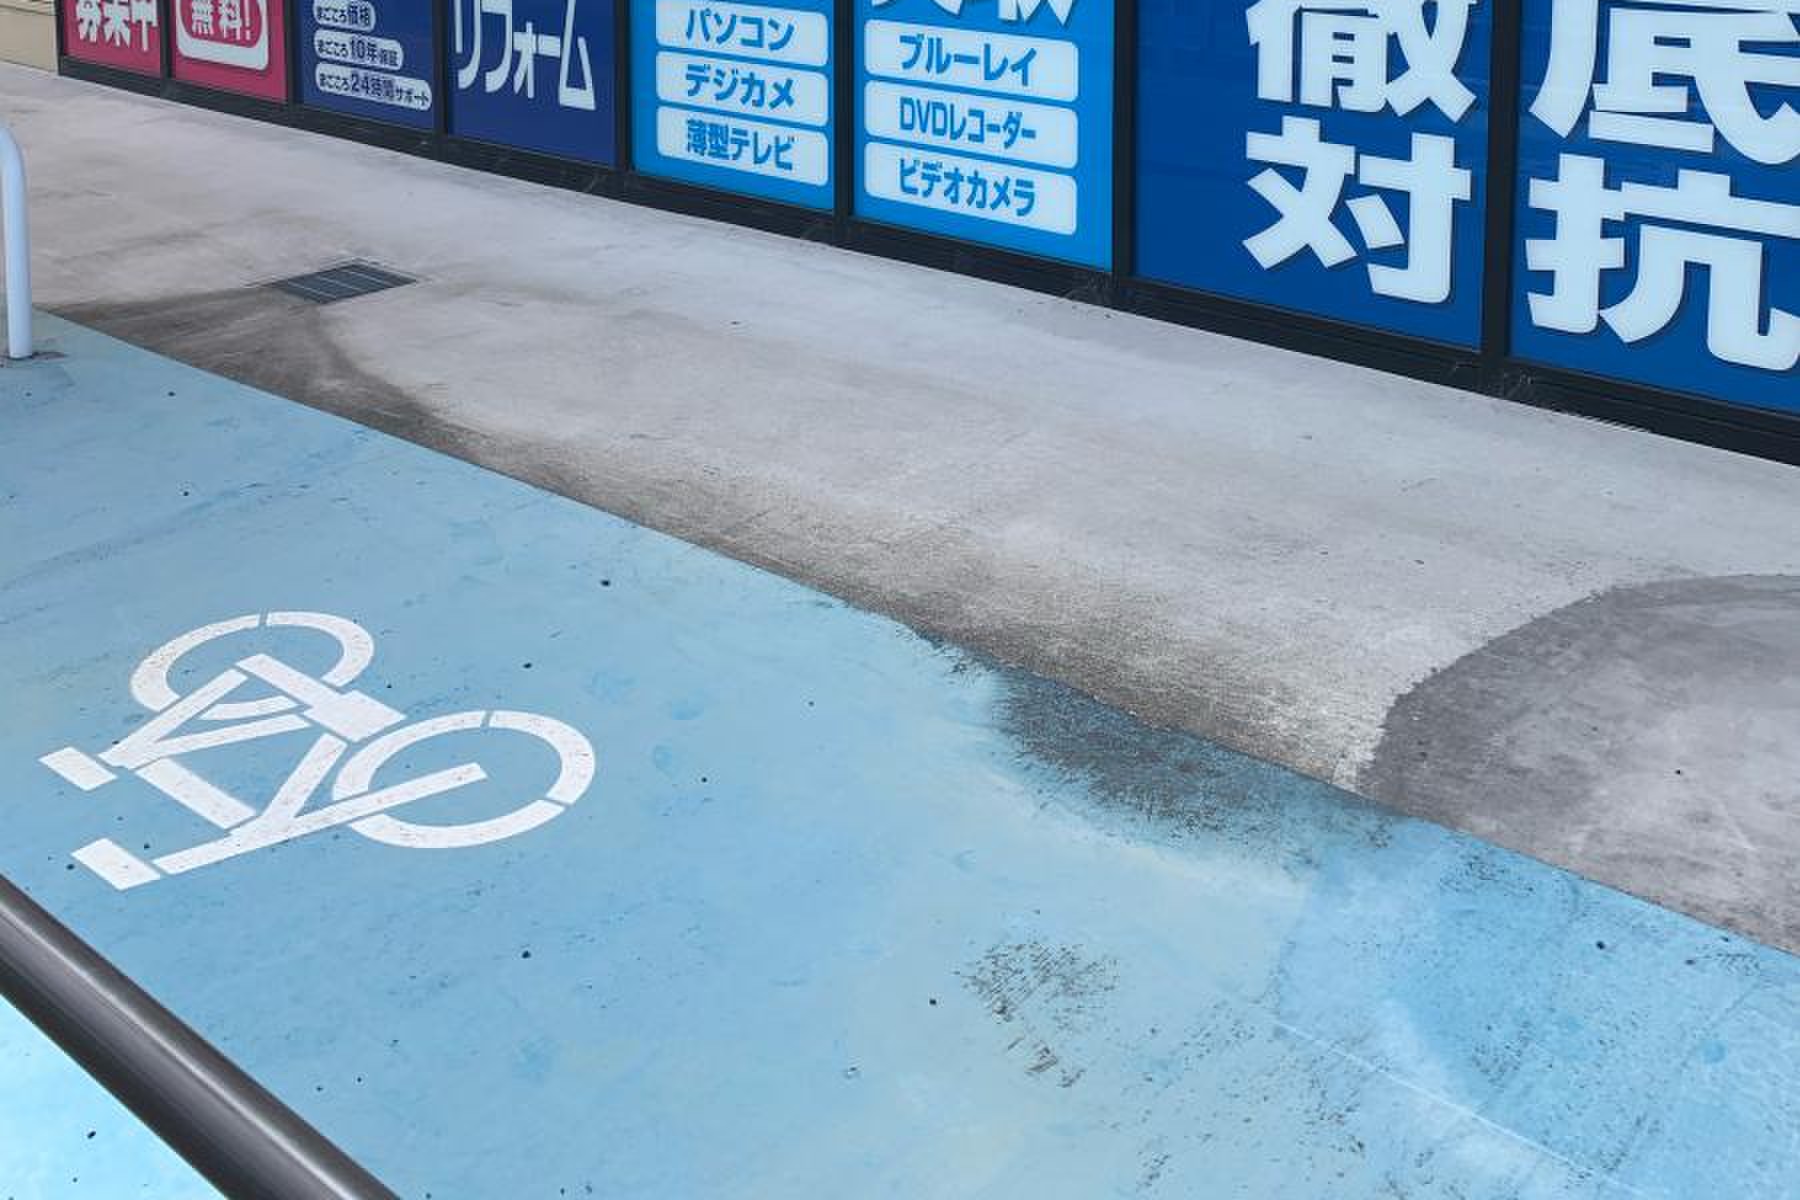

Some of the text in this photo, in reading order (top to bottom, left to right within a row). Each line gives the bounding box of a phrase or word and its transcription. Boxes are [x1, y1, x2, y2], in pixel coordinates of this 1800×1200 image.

[685, 7, 795, 51] パソコン
[685, 63, 795, 109] デジカメ
[899, 33, 1038, 88] ブルーレイ
[685, 119, 795, 171] 薄型テレビ
[900, 97, 1038, 150] DVDレコーダー
[899, 158, 1036, 217] ビデオカメラ
